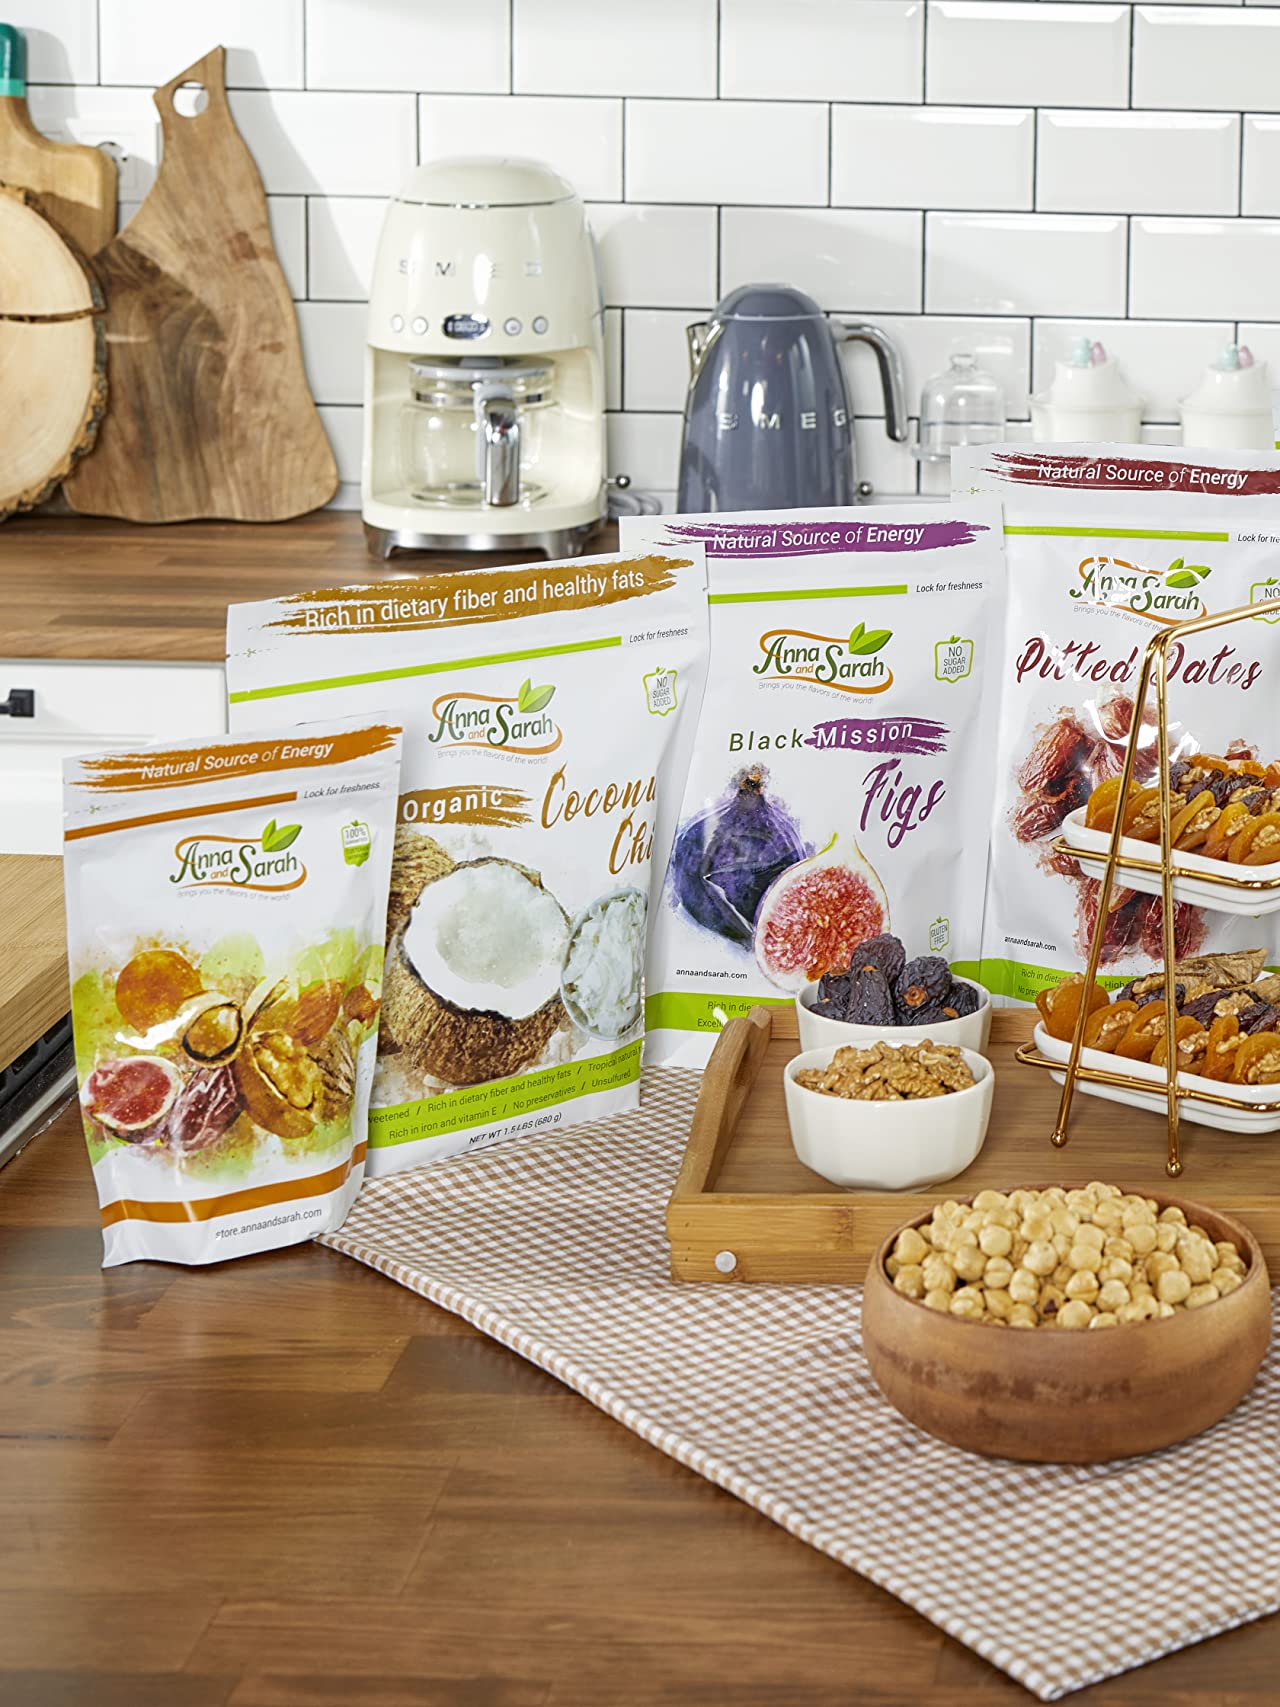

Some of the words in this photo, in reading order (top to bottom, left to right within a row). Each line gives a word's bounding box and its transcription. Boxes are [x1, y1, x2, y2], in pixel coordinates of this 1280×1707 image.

[1038, 464, 1100, 479] Natural
[1105, 465, 1163, 483] Source
[1168, 467, 1188, 484] of
[1190, 470, 1248, 489] Energy
[713, 532, 777, 551] Natural
[781, 530, 840, 546] Source
[844, 526, 863, 543] of
[866, 526, 924, 546] Energy
[304, 602, 351, 628] Rich
[357, 604, 375, 624] in
[381, 596, 448, 621] dietary
[453, 589, 498, 611] fiber
[503, 584, 538, 604] and
[543, 573, 607, 600] healthy
[612, 568, 644, 588] fats
[916, 583, 934, 592] Lock
[936, 581, 946, 592] for
[947, 581, 982, 591] freshness
[1130, 576, 1199, 612] Sarah
[753, 636, 819, 675] Anna
[815, 645, 884, 683] Sarah
[943, 656, 966, 666] SUGAR
[948, 647, 962, 658] NO
[1016, 635, 1139, 684] Pitted
[656, 676, 668, 688] NO
[795, 663, 814, 674] and
[942, 665, 965, 675] ADDED
[652, 686, 670, 699] SUGAR
[653, 697, 672, 708] ADDED
[428, 699, 490, 743] Anna
[486, 704, 553, 746] Sarah
[467, 727, 485, 740] and
[730, 729, 804, 751] Black
[816, 723, 913, 747] Mission
[141, 756, 200, 779] Natural
[203, 752, 258, 769] Source
[262, 747, 278, 761] of
[281, 743, 333, 759] Energy
[402, 786, 503, 822] Organic
[541, 760, 655, 829] Coconu
[860, 758, 946, 849] Figs
[608, 810, 654, 874] Chi
[170, 842, 232, 883] Anna
[231, 845, 297, 884] Sarah
[211, 868, 228, 879] and
[676, 967, 747, 980] annaandsarah.com
[427, 1103, 446, 1113] Rich
[449, 1100, 457, 1109] in
[460, 1093, 488, 1107] dietary
[489, 1086, 509, 1098] fiber
[510, 1083, 525, 1093] and
[527, 1075, 555, 1091] healthy
[556, 1068, 571, 1080] fats
[513, 1100, 524, 1110] No
[526, 1085, 576, 1106] preservatives
[592, 1068, 631, 1087] Unsulfured
[469, 1133, 487, 1144] NET
[488, 1129, 502, 1138] WT
[504, 1125, 516, 1135] 1.5
[517, 1121, 533, 1131] LBS
[534, 1116, 552, 1127] (680
[553, 1112, 562, 1123] g)
